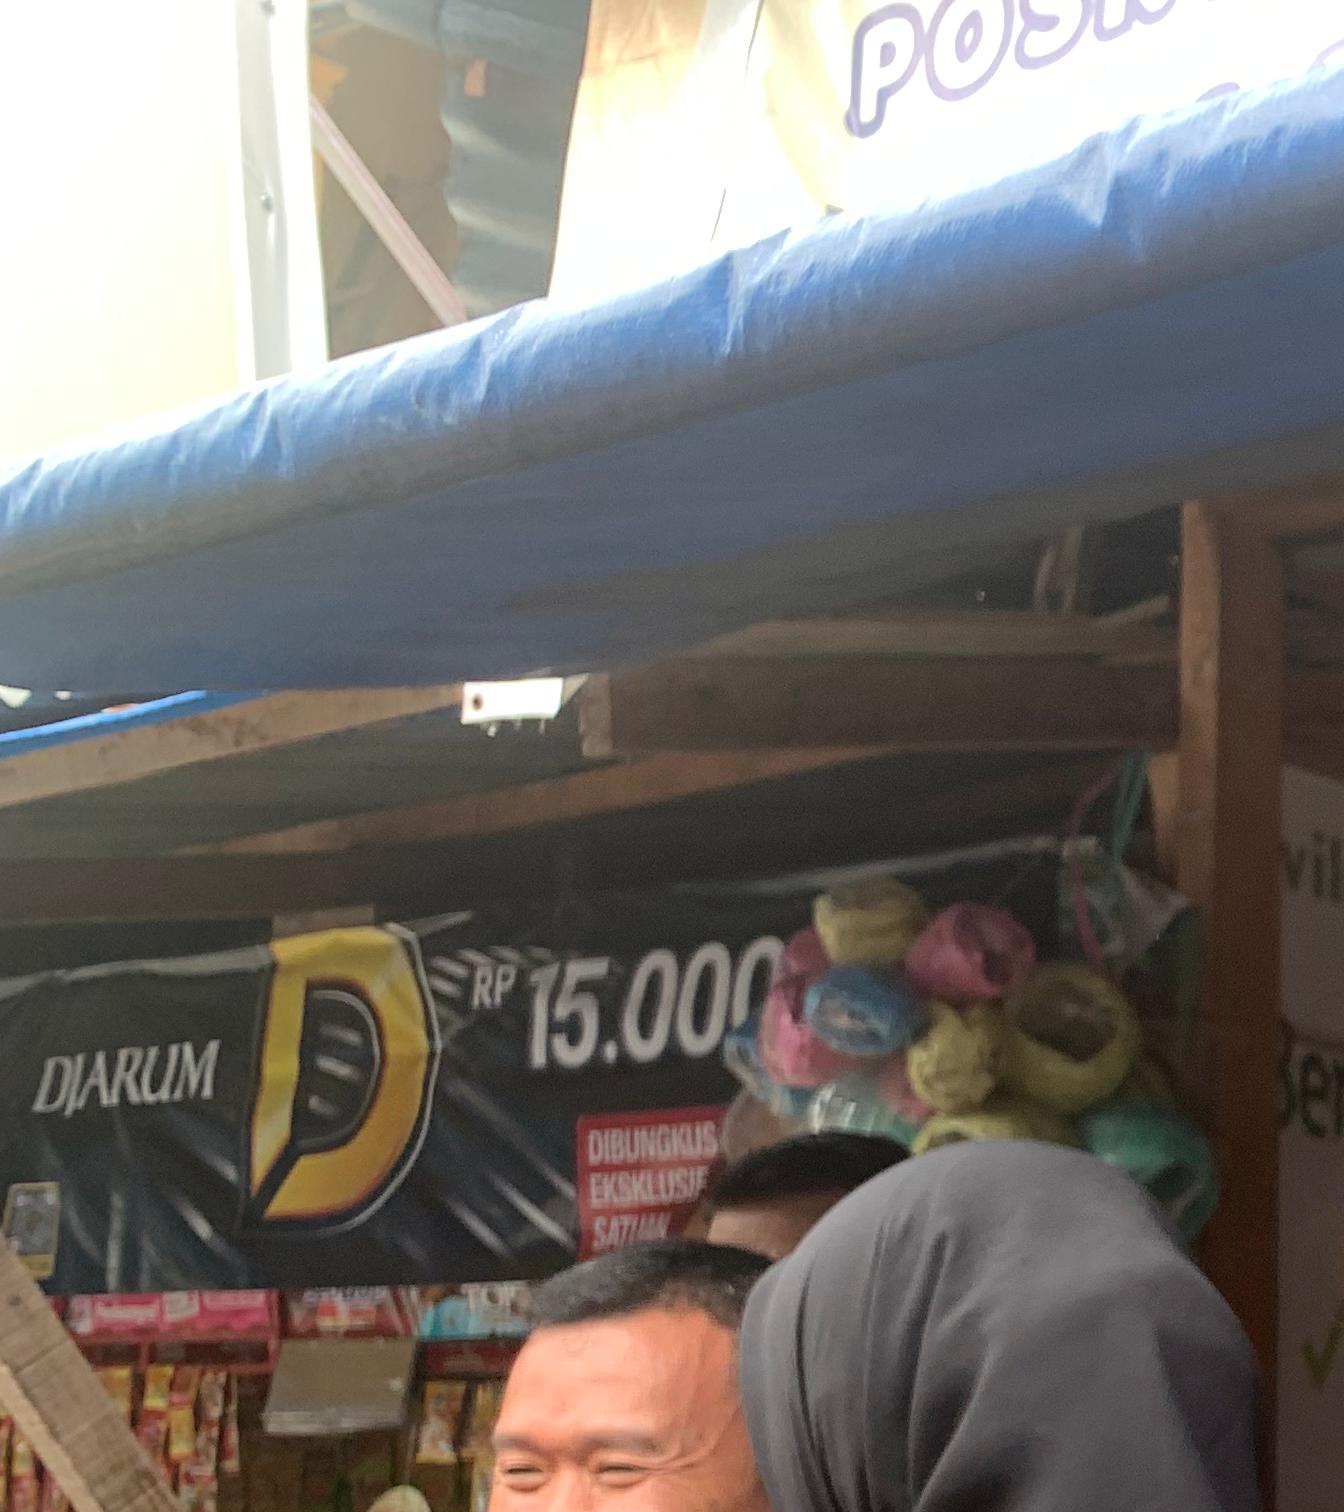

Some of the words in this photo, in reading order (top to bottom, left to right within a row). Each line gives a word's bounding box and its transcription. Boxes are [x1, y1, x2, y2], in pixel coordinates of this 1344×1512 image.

[469, 964, 516, 1008] RP
[32, 1039, 221, 1117] DJARUM
[588, 1120, 718, 1165] DIBUNGKUS
